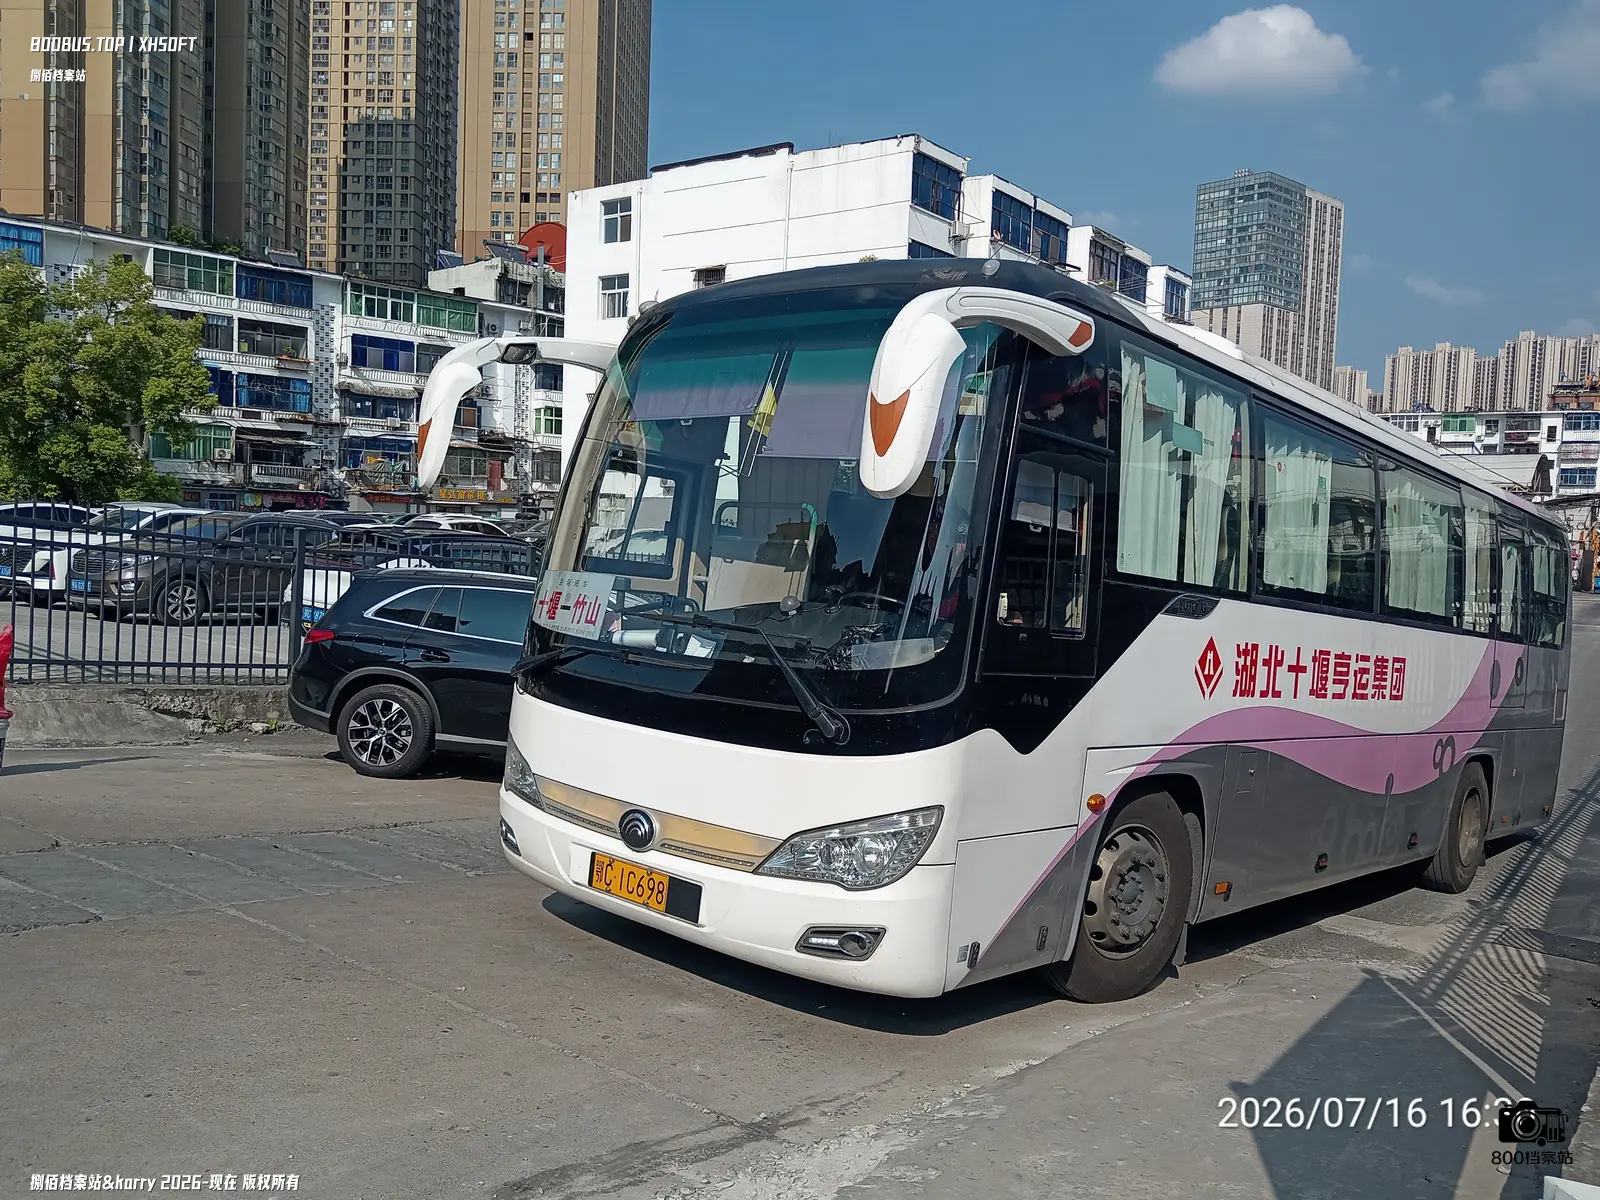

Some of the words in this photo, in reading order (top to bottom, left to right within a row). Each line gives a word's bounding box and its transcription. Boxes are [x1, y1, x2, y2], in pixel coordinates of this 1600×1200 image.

[1232, 642, 1407, 701] 湖北十堰亨运集团
